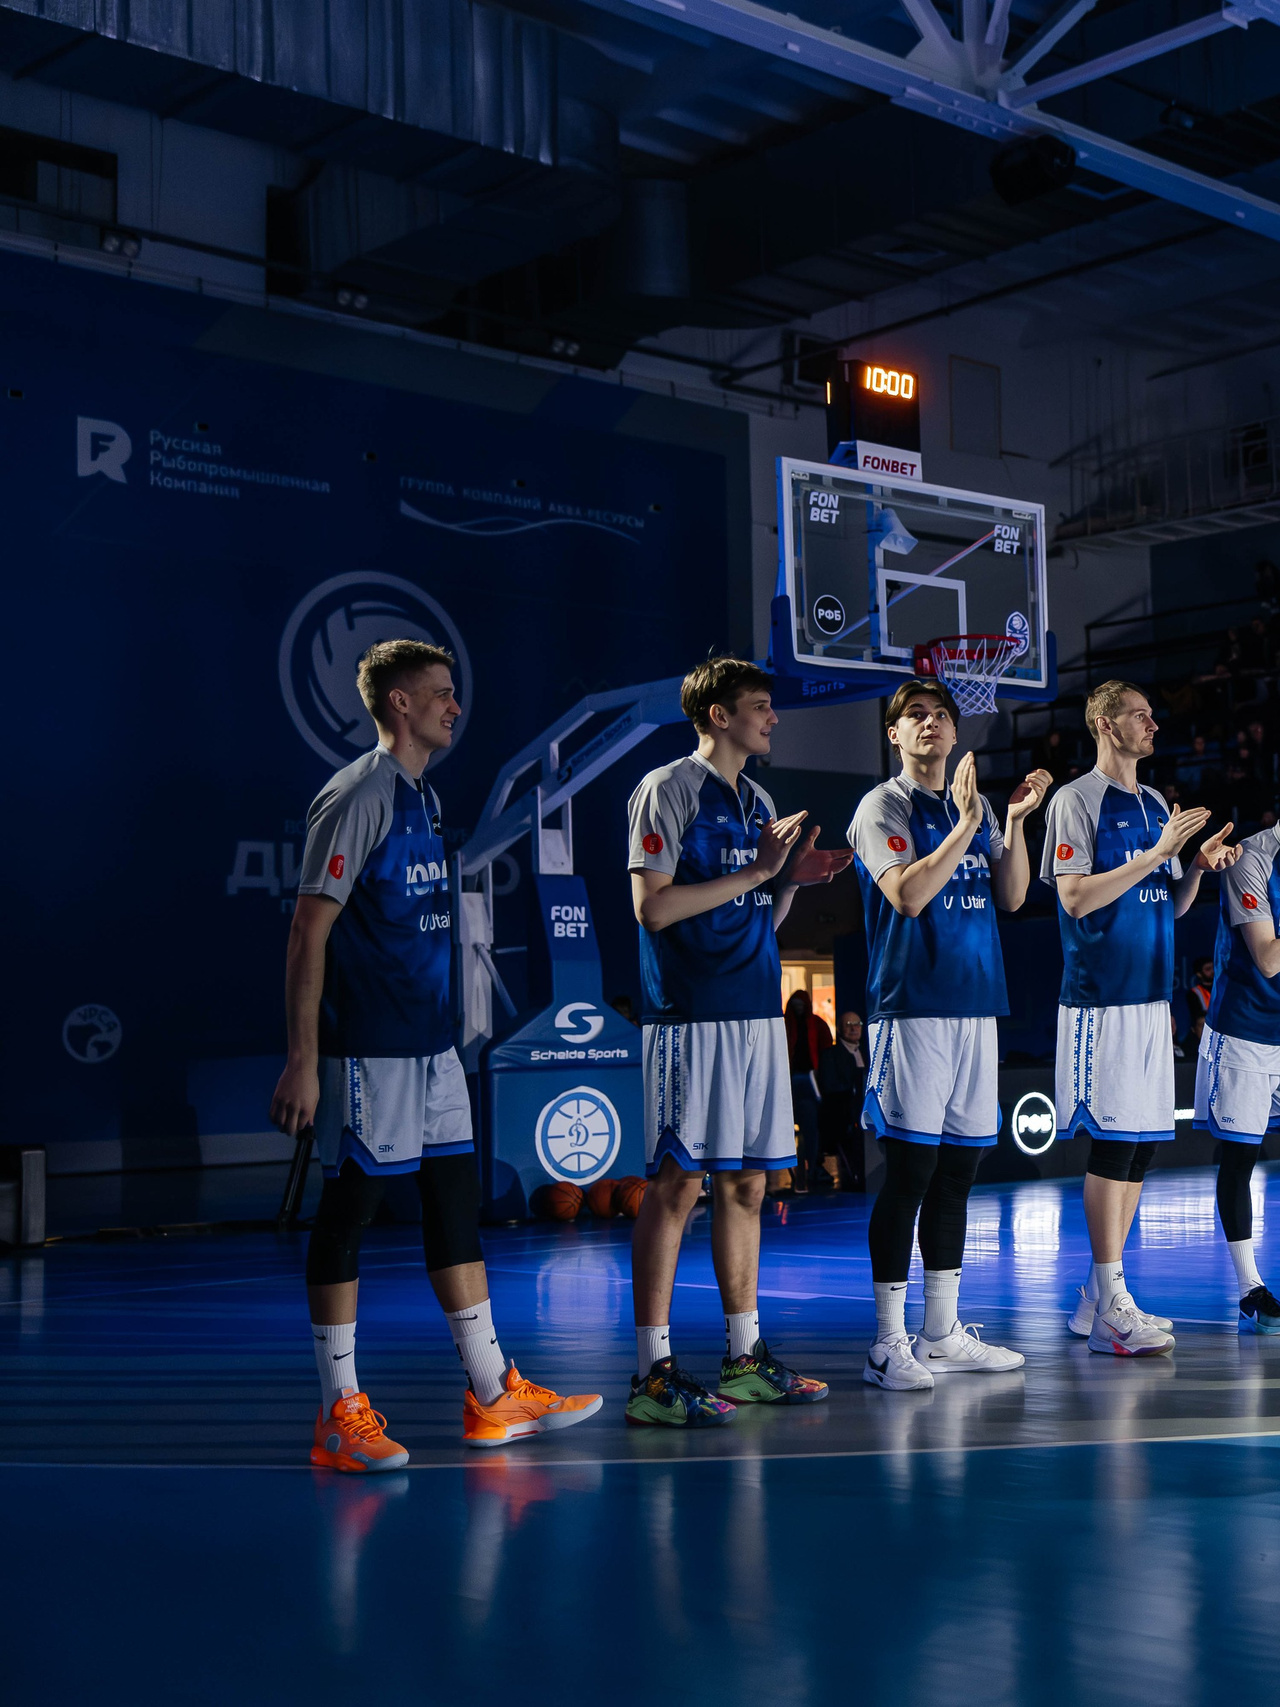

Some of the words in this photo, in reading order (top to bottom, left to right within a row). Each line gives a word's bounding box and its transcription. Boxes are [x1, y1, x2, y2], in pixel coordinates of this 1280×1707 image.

[865, 366, 914, 399] 10:00
[150, 429, 223, 456] Русская
[149, 450, 331, 494] Рыбопромышленная
[862, 455, 918, 476] FONBET
[149, 470, 241, 499] Компания
[400, 475, 456, 497] ГРУППА
[462, 487, 542, 511] КОМПАНИЙ
[809, 491, 840, 509] FON
[809, 507, 841, 524] BET
[993, 524, 1021, 541] FON
[994, 539, 1021, 555] BET
[817, 608, 842, 621] РФБ
[551, 905, 586, 921] FON
[554, 921, 588, 938] BET
[530, 1050, 586, 1061] Schelde
[587, 1048, 628, 1061] Sports
[1221, 1116, 1236, 1124] STK
[378, 1144, 395, 1153] STK
[692, 1142, 709, 1151] STK
